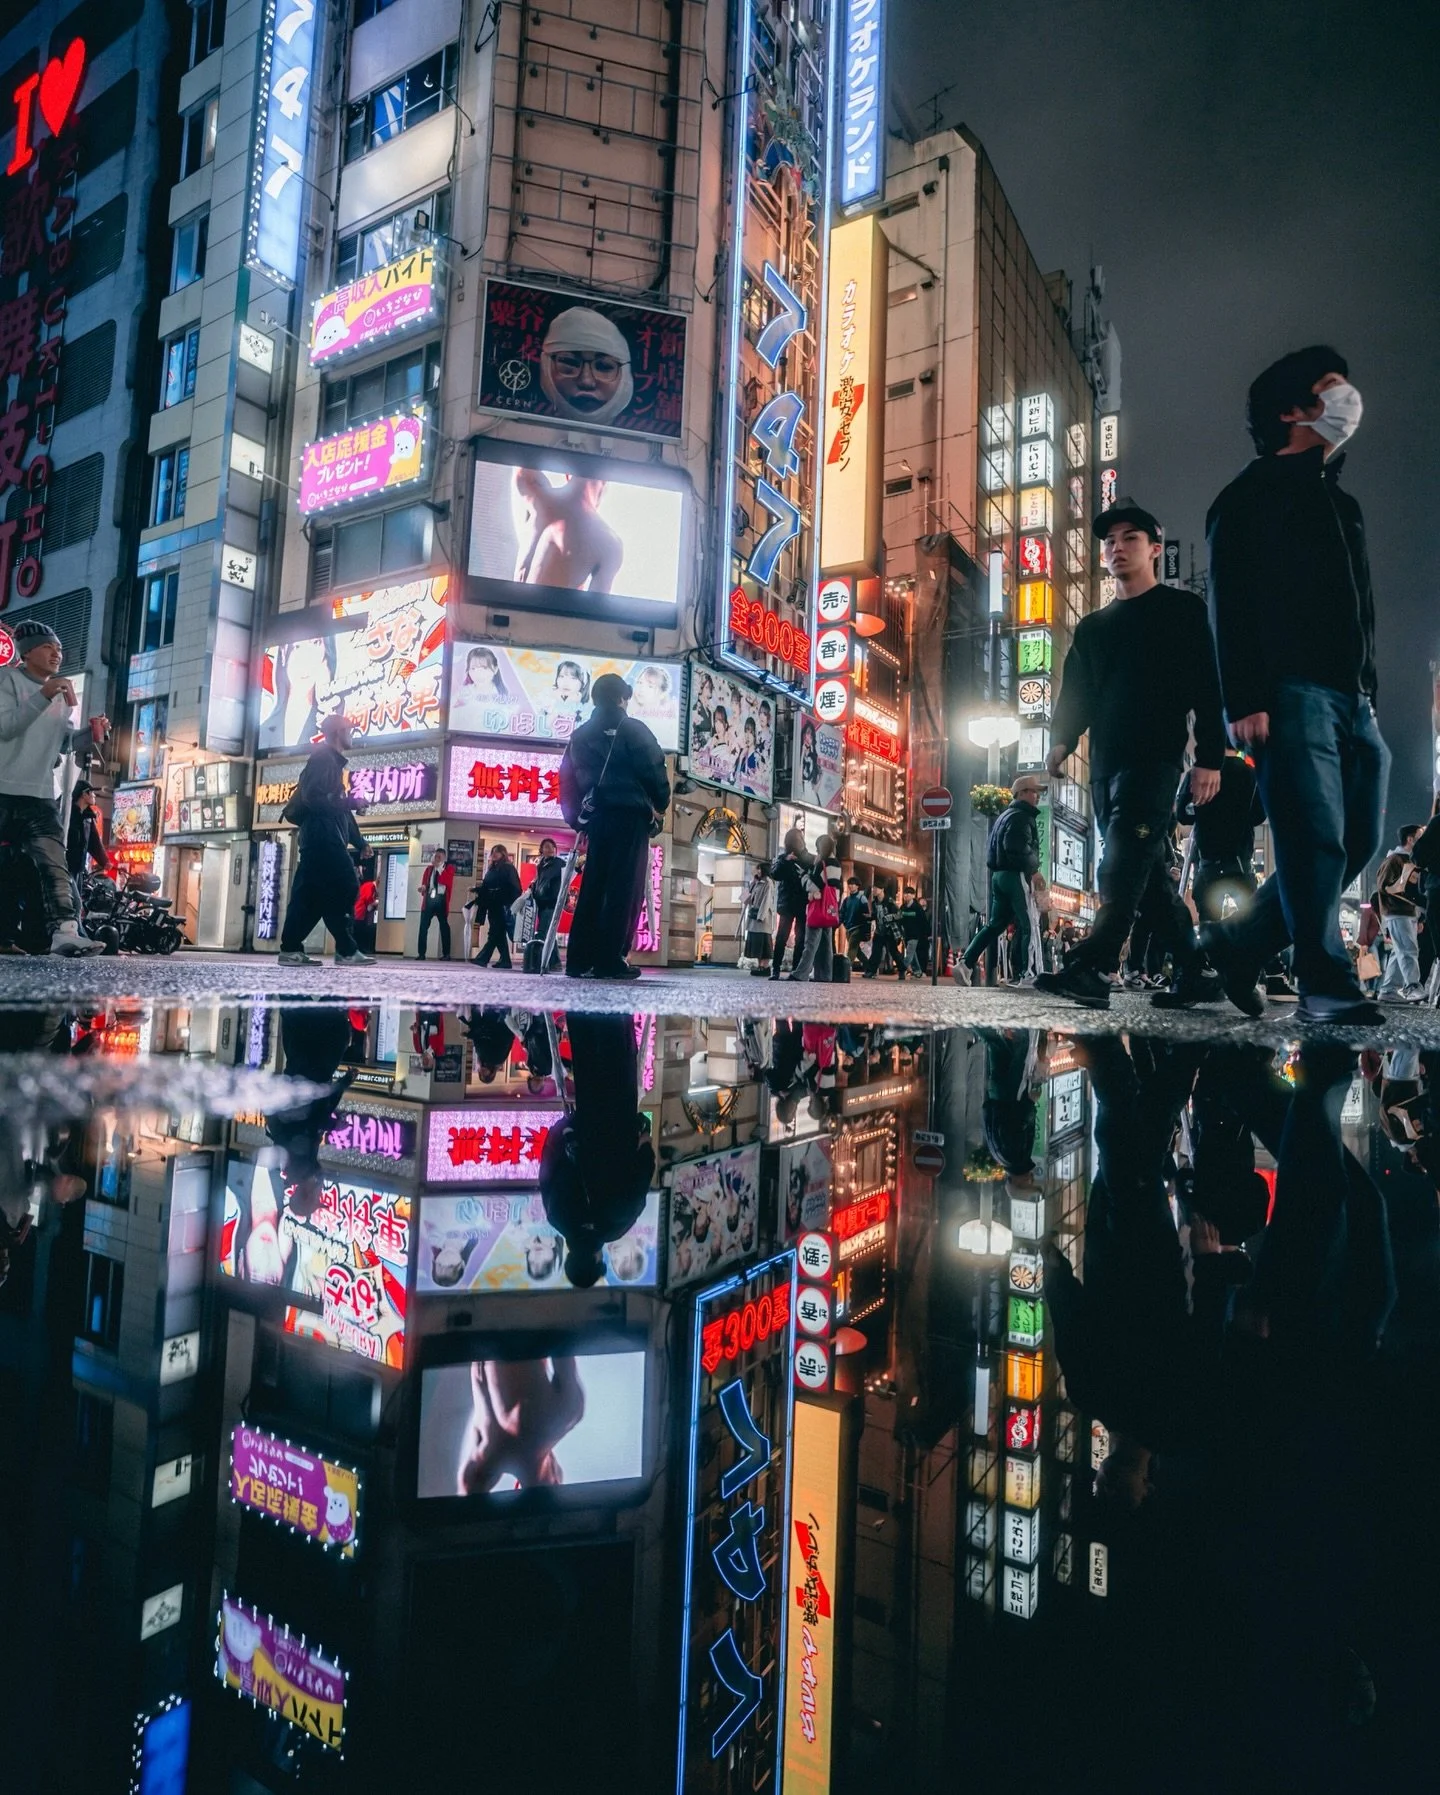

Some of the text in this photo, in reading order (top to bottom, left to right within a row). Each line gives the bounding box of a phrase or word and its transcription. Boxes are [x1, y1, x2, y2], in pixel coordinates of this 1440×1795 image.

[7, 72, 40, 177] I
[333, 253, 433, 315] 高収入バイト
[633, 325, 657, 415] オープン
[303, 424, 388, 472] 入店応援金
[730, 585, 811, 675] 全300室
[483, 709, 587, 738] ゆほしグ
[350, 762, 427, 803] 案内所
[521, 905, 535, 946] TRADER
